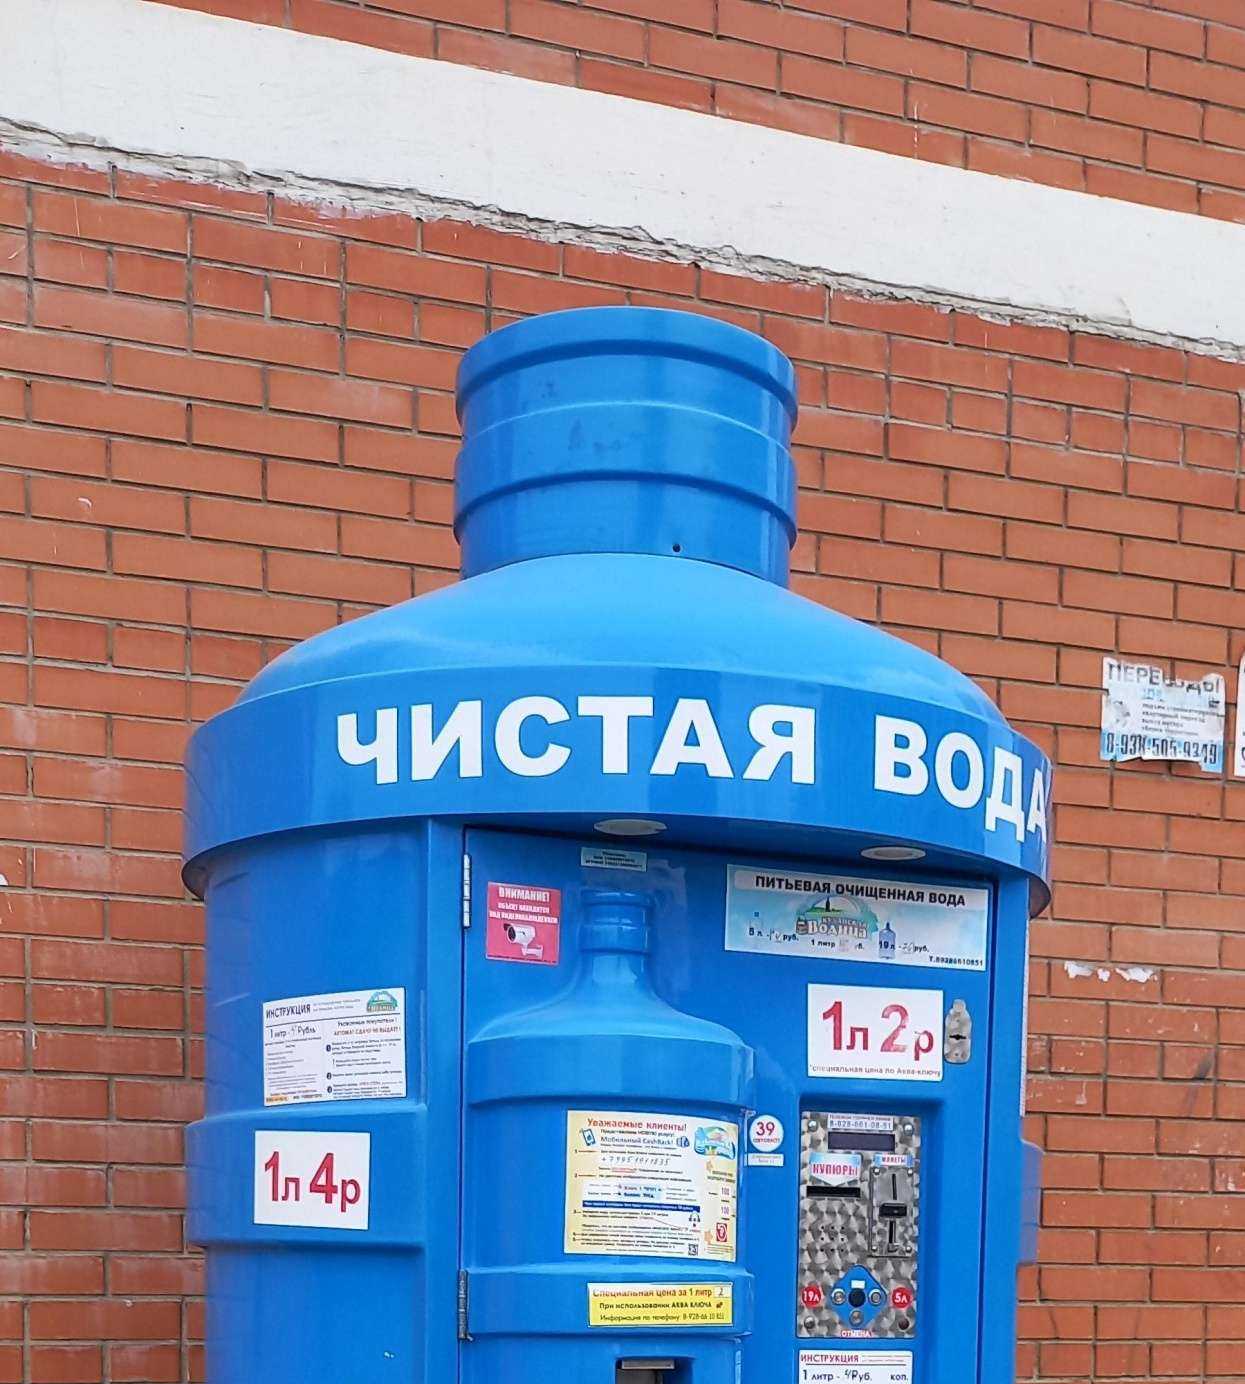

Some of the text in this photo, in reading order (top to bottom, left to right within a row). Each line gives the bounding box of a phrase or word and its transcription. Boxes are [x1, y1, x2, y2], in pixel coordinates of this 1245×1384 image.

[337, 695, 1047, 843] ЧИСТАЯ ВОДА
[755, 875, 966, 907] ПИТЬЕВАЯ ОЧИЩЕННАЯ ВОДА
[783, 933, 799, 942] руб.
[914, 944, 930, 953] руб.
[266, 1003, 311, 1019] ИНСТРУКЦИЯ
[822, 1001, 934, 1061] 1л 2р
[587, 1118, 687, 1132] Уважаемые клиенты!
[756, 1121, 775, 1136] 39
[813, 1163, 858, 1176] КУПЮРЫ
[264, 1151, 361, 1213] 1л 4р
[592, 1288, 654, 1298] Специальная
[689, 1288, 693, 1296] 1
[695, 1289, 712, 1298] литр
[599, 1302, 614, 1310] При
[600, 1314, 641, 1322] Информация
[800, 1354, 859, 1363] ИНСТРУКЦИЯ
[803, 1369, 807, 1380] 1
[811, 1373, 834, 1382] литр
[890, 1373, 909, 1381] коп.
